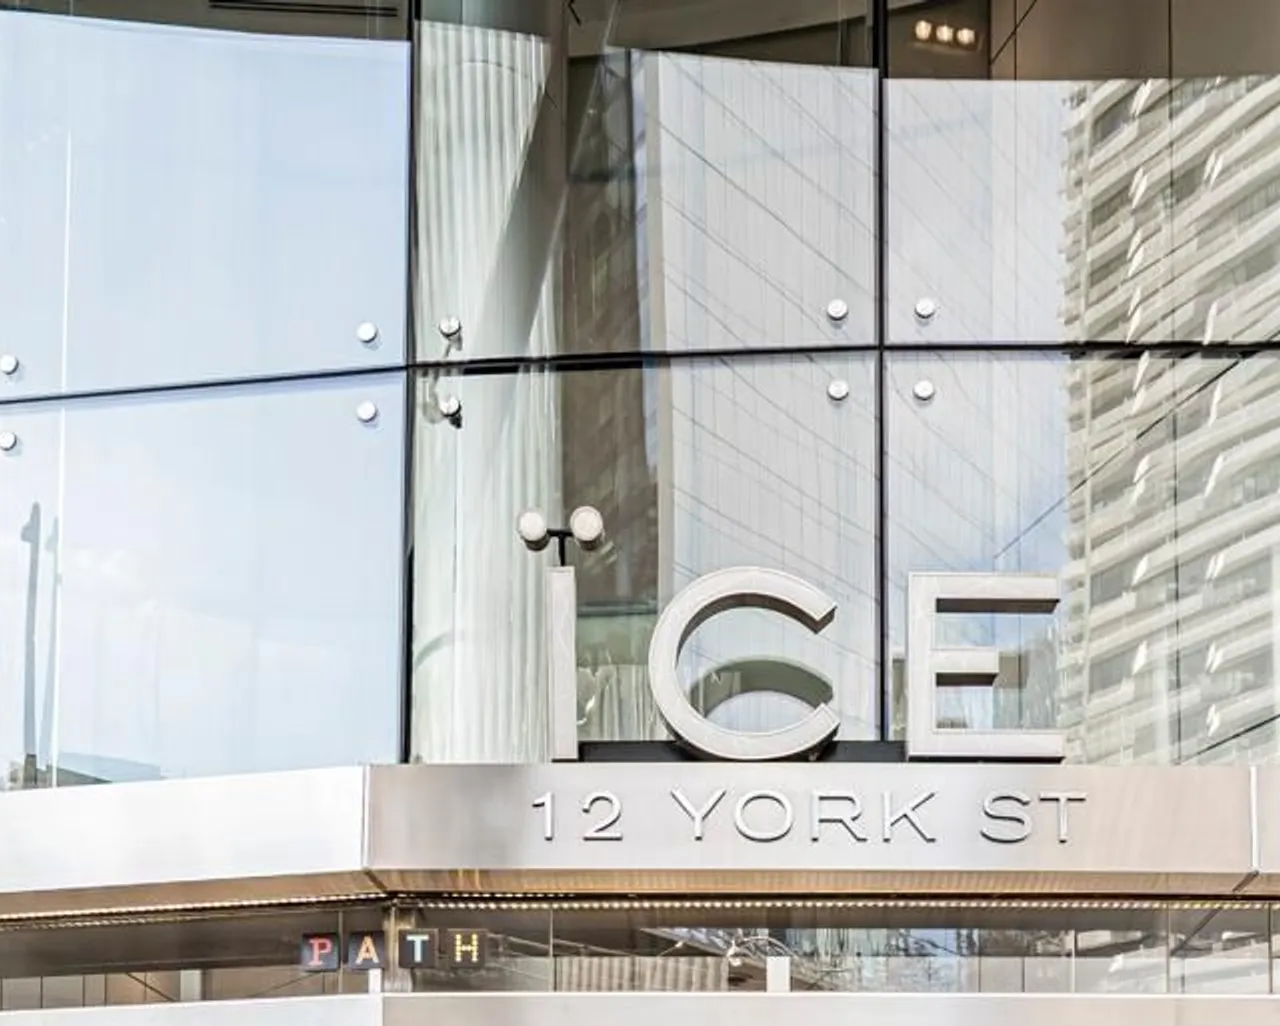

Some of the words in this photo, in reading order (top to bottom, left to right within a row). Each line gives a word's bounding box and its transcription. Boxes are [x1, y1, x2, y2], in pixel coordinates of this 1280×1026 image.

[547, 566, 1066, 761] ICE
[531, 790, 623, 842] 12
[670, 790, 938, 843] YORK
[980, 791, 1088, 844] ST
[308, 933, 479, 967] PATH
